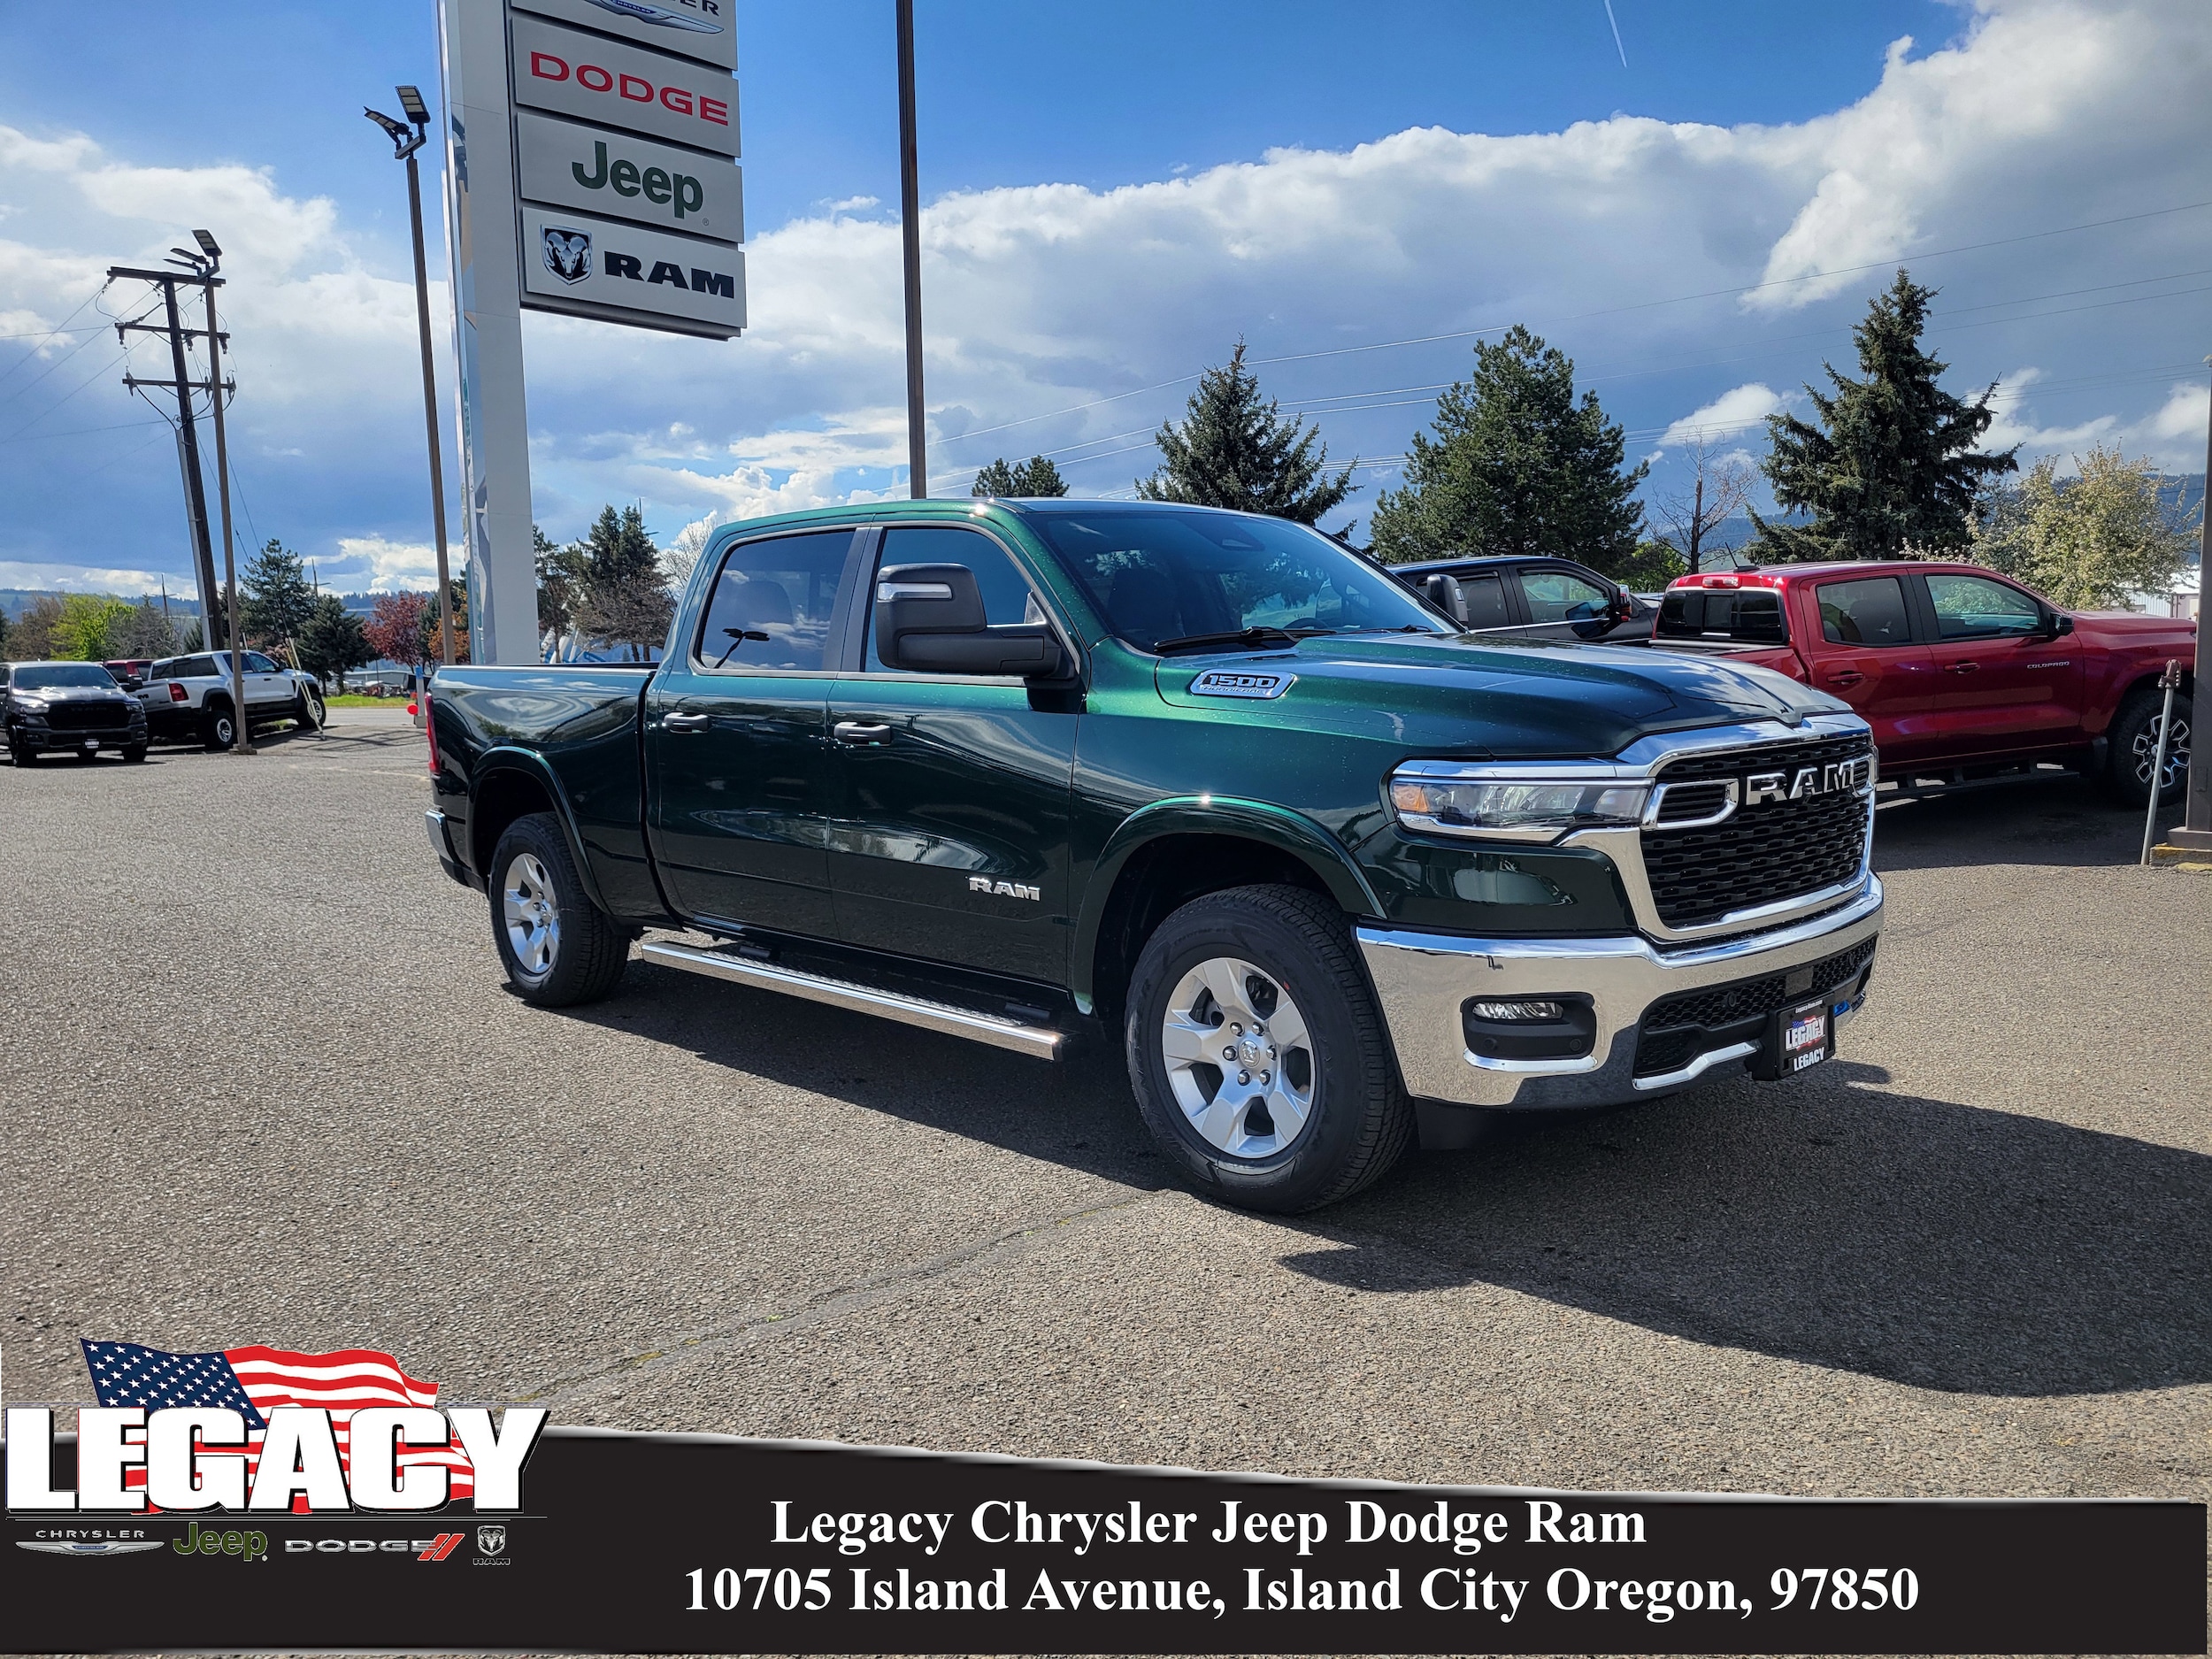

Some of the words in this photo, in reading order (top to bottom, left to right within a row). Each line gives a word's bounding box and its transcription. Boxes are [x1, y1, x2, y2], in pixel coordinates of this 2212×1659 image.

[531, 51, 728, 126] DODGE
[572, 141, 703, 219] Jeep
[604, 250, 734, 299] RAM
[1209, 674, 1276, 688] 1500
[1746, 762, 1856, 805] RAM
[969, 877, 1041, 901] RAM
[1786, 1017, 1825, 1049] LEGACY
[1793, 1047, 1825, 1071] LEGACY
